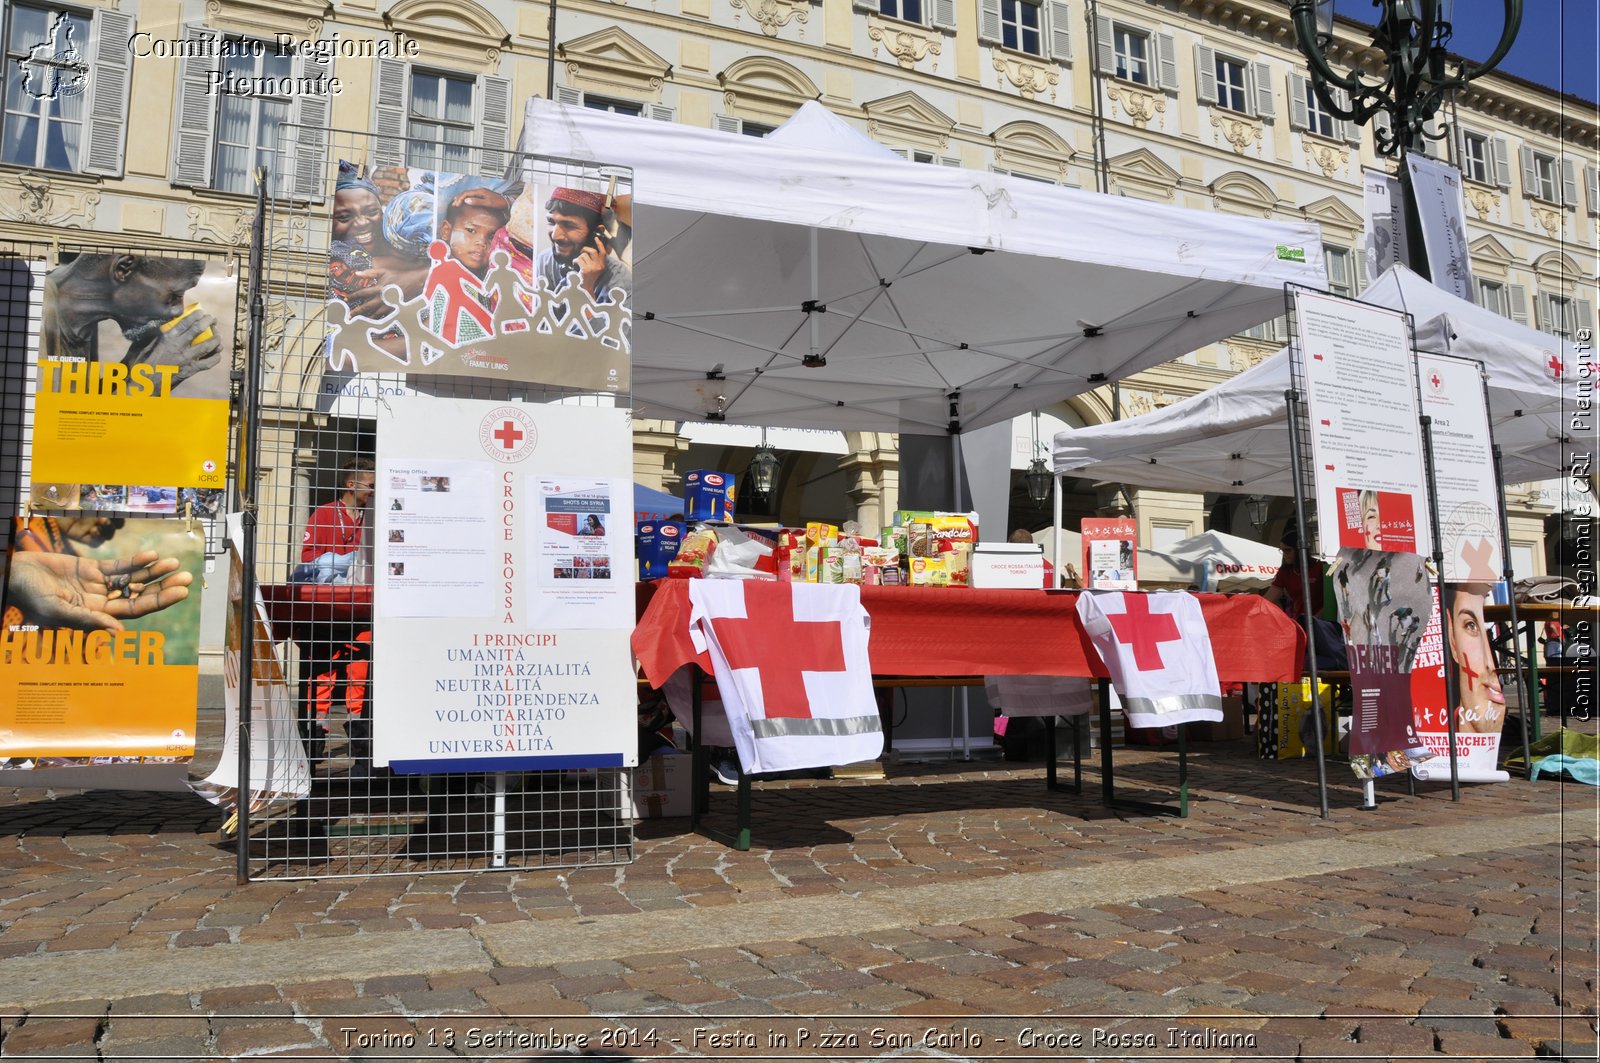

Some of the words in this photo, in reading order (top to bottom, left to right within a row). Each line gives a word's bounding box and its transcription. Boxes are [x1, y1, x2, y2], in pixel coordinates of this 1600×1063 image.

[37, 359, 179, 398] THIRST
[1434, 418, 1446, 426] Area
[198, 474, 219, 482] ICRC
[503, 471, 514, 541] CROCE
[1216, 563, 1255, 574] CROCE
[503, 553, 514, 624] ROSSA
[0, 630, 165, 665] HUNGER
[474, 634, 478, 647] I
[485, 634, 557, 647] PRINCIPI
[477, 693, 600, 707] INDIPENDENZA
[435, 708, 565, 722] VOLONTARIATO
[1458, 705, 1481, 726] sei
[1488, 736, 1496, 746] TU
